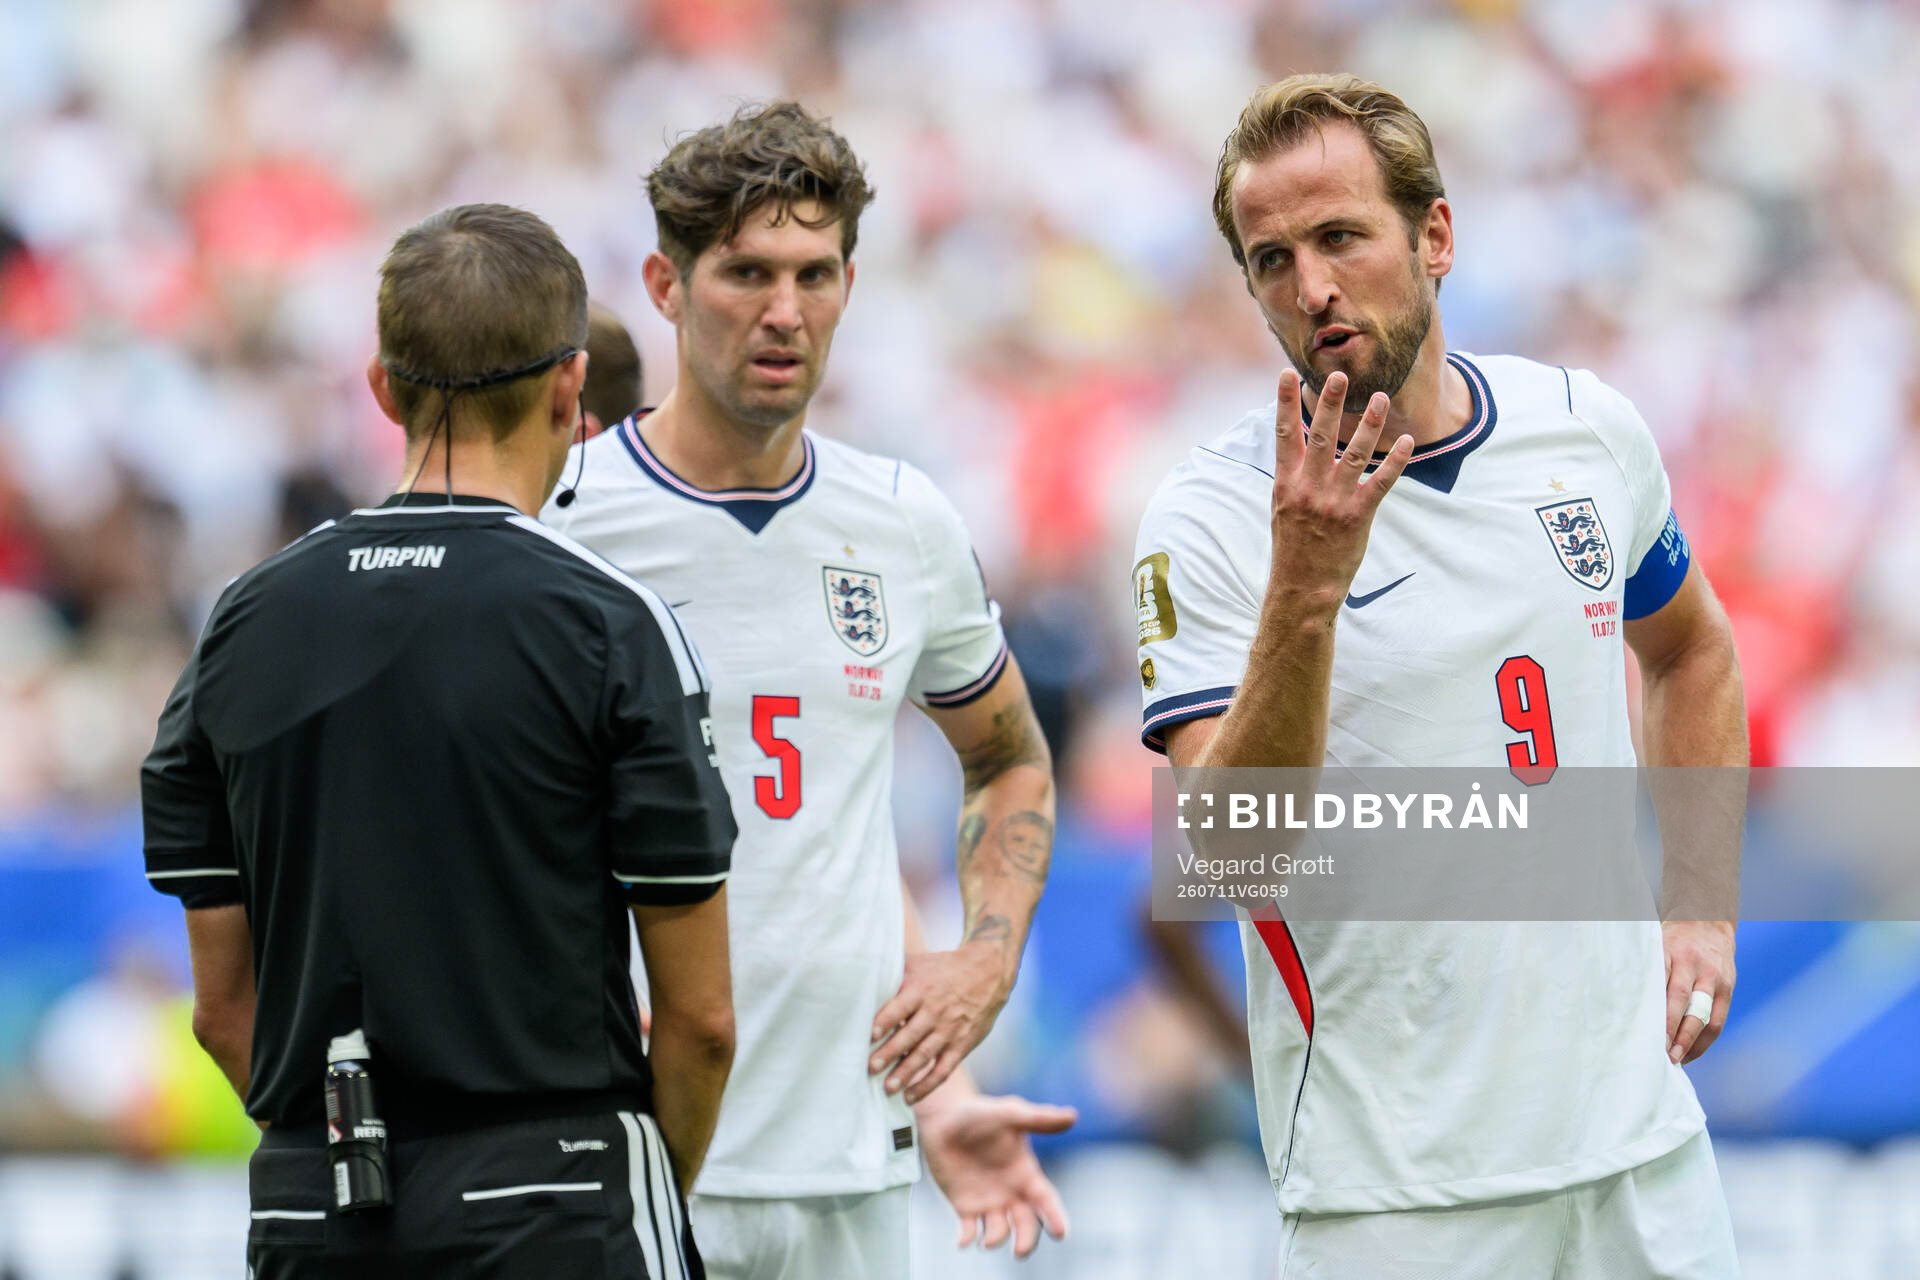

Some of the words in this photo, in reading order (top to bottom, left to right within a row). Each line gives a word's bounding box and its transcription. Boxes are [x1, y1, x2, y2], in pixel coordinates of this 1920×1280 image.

[348, 545, 446, 572] TURPIN
[1583, 600, 1618, 619] NORWAY
[752, 695, 802, 819] 5
[1495, 655, 1558, 787] 9
